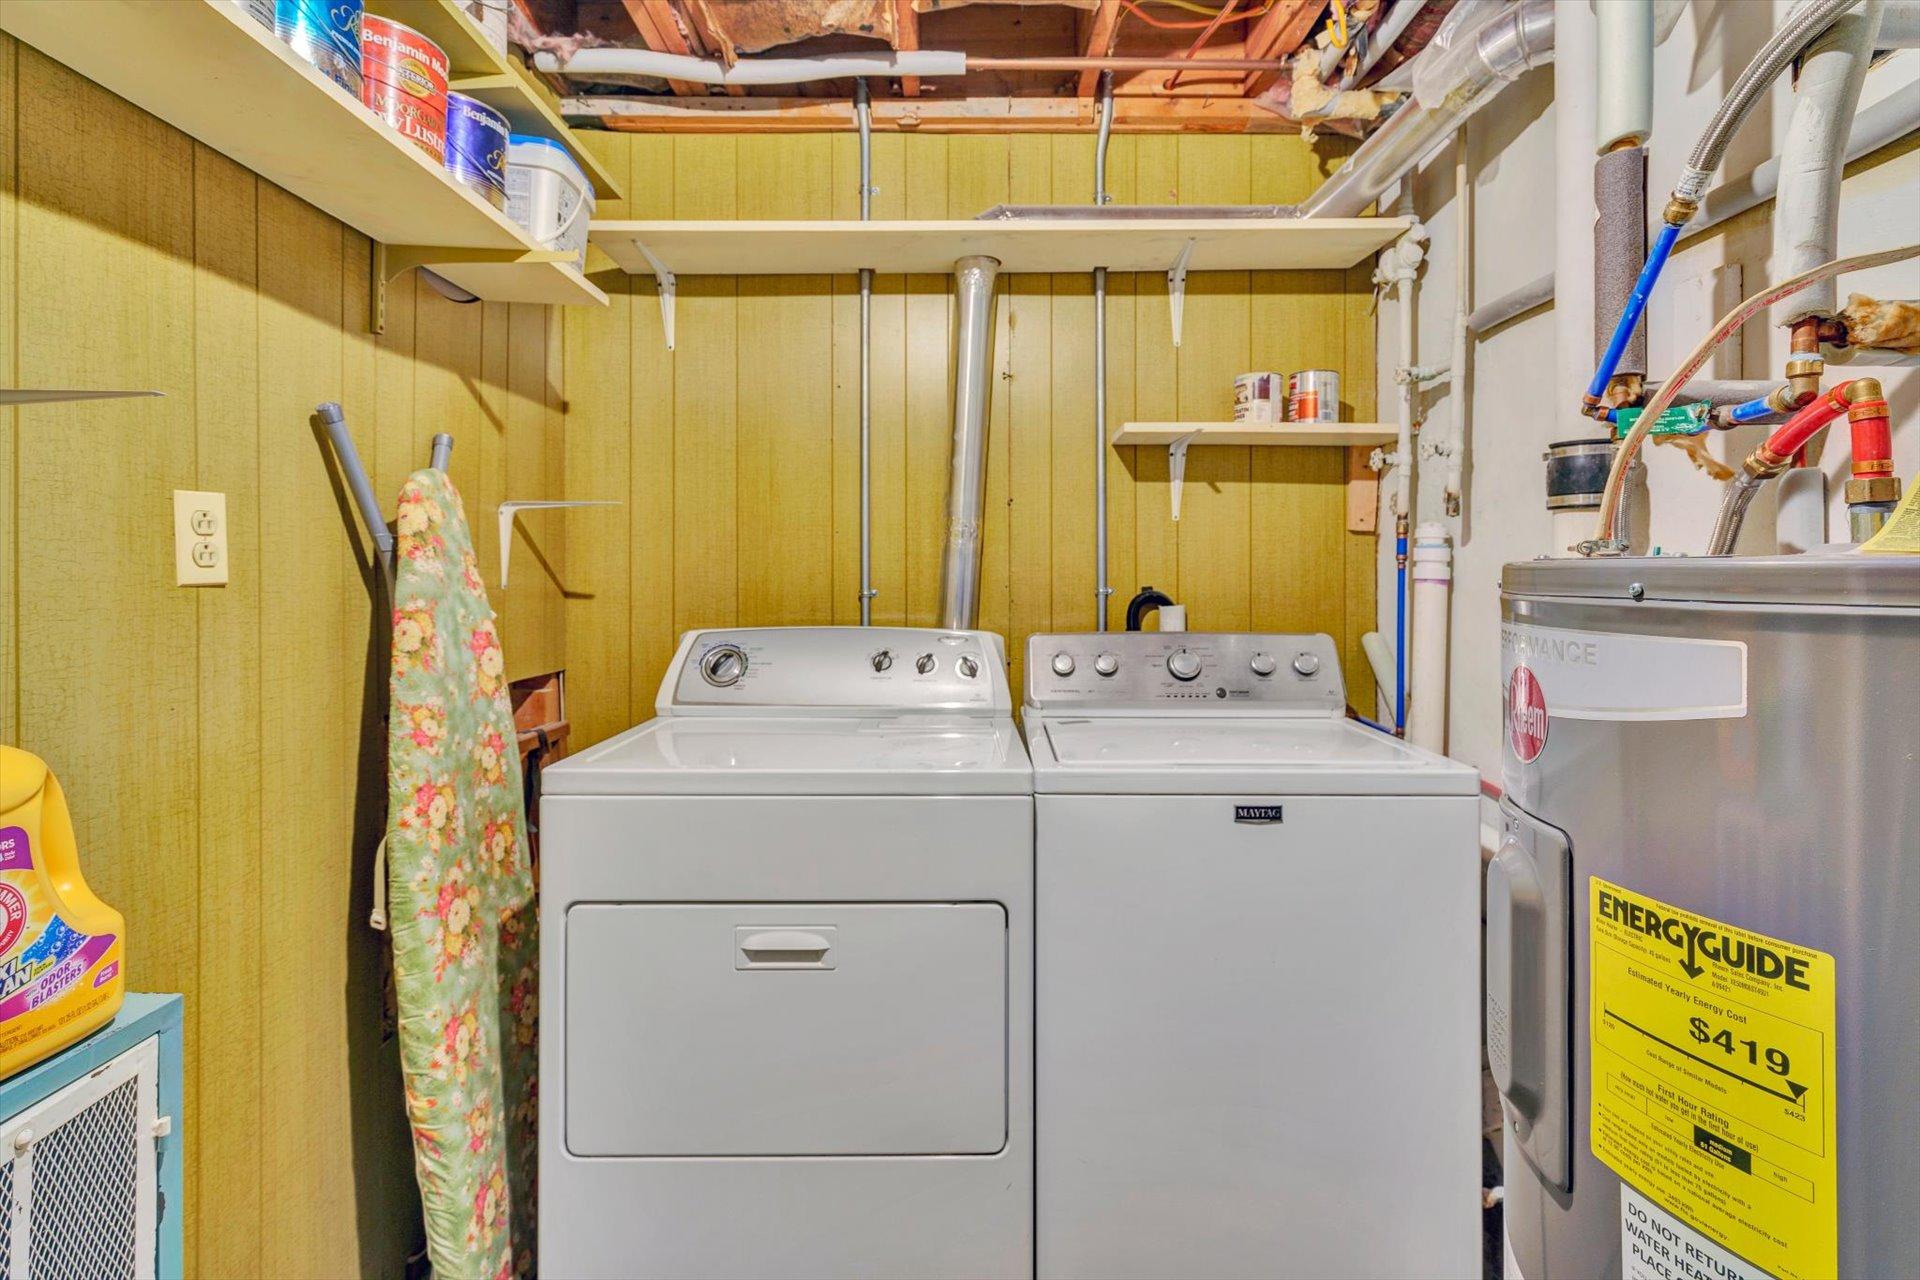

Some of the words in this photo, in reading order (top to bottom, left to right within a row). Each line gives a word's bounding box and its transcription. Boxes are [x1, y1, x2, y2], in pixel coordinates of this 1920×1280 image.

[362, 28, 430, 66] Benjamin
[462, 105, 508, 137] Benjamin
[1237, 808, 1281, 818] MAYTAG
[1599, 889, 1810, 992] ENERGYGUIDE
[31, 963, 82, 1010] BLASTERS
[40, 961, 71, 990] ODOR
[1627, 966, 1663, 990] Estimated
[1665, 983, 1691, 1003] Yearly
[1693, 996, 1723, 1016] Energy
[1726, 1009, 1747, 1025] Cost
[1689, 1017, 1790, 1076] $419
[1705, 1078, 1727, 1094] Models
[1657, 1084, 1675, 1100] First
[1678, 1094, 1697, 1112] Hour
[1700, 1107, 1730, 1129] Rating
[1721, 1125, 1736, 1140] hour
[1737, 1135, 1744, 1144] of
[1745, 1141, 1759, 1153] use)
[1702, 1177, 1731, 1199] electricity
[1731, 1195, 1746, 1207] with
[1625, 1218, 1671, 1261] WATER
[1628, 1202, 1647, 1224] DO
[1651, 1219, 1681, 1247] NOT
[1712, 1202, 1736, 1220] average
[1738, 1217, 1771, 1240] electricity
[1773, 1235, 1788, 1249] cost
[1632, 1243, 1672, 1280] PLACE
